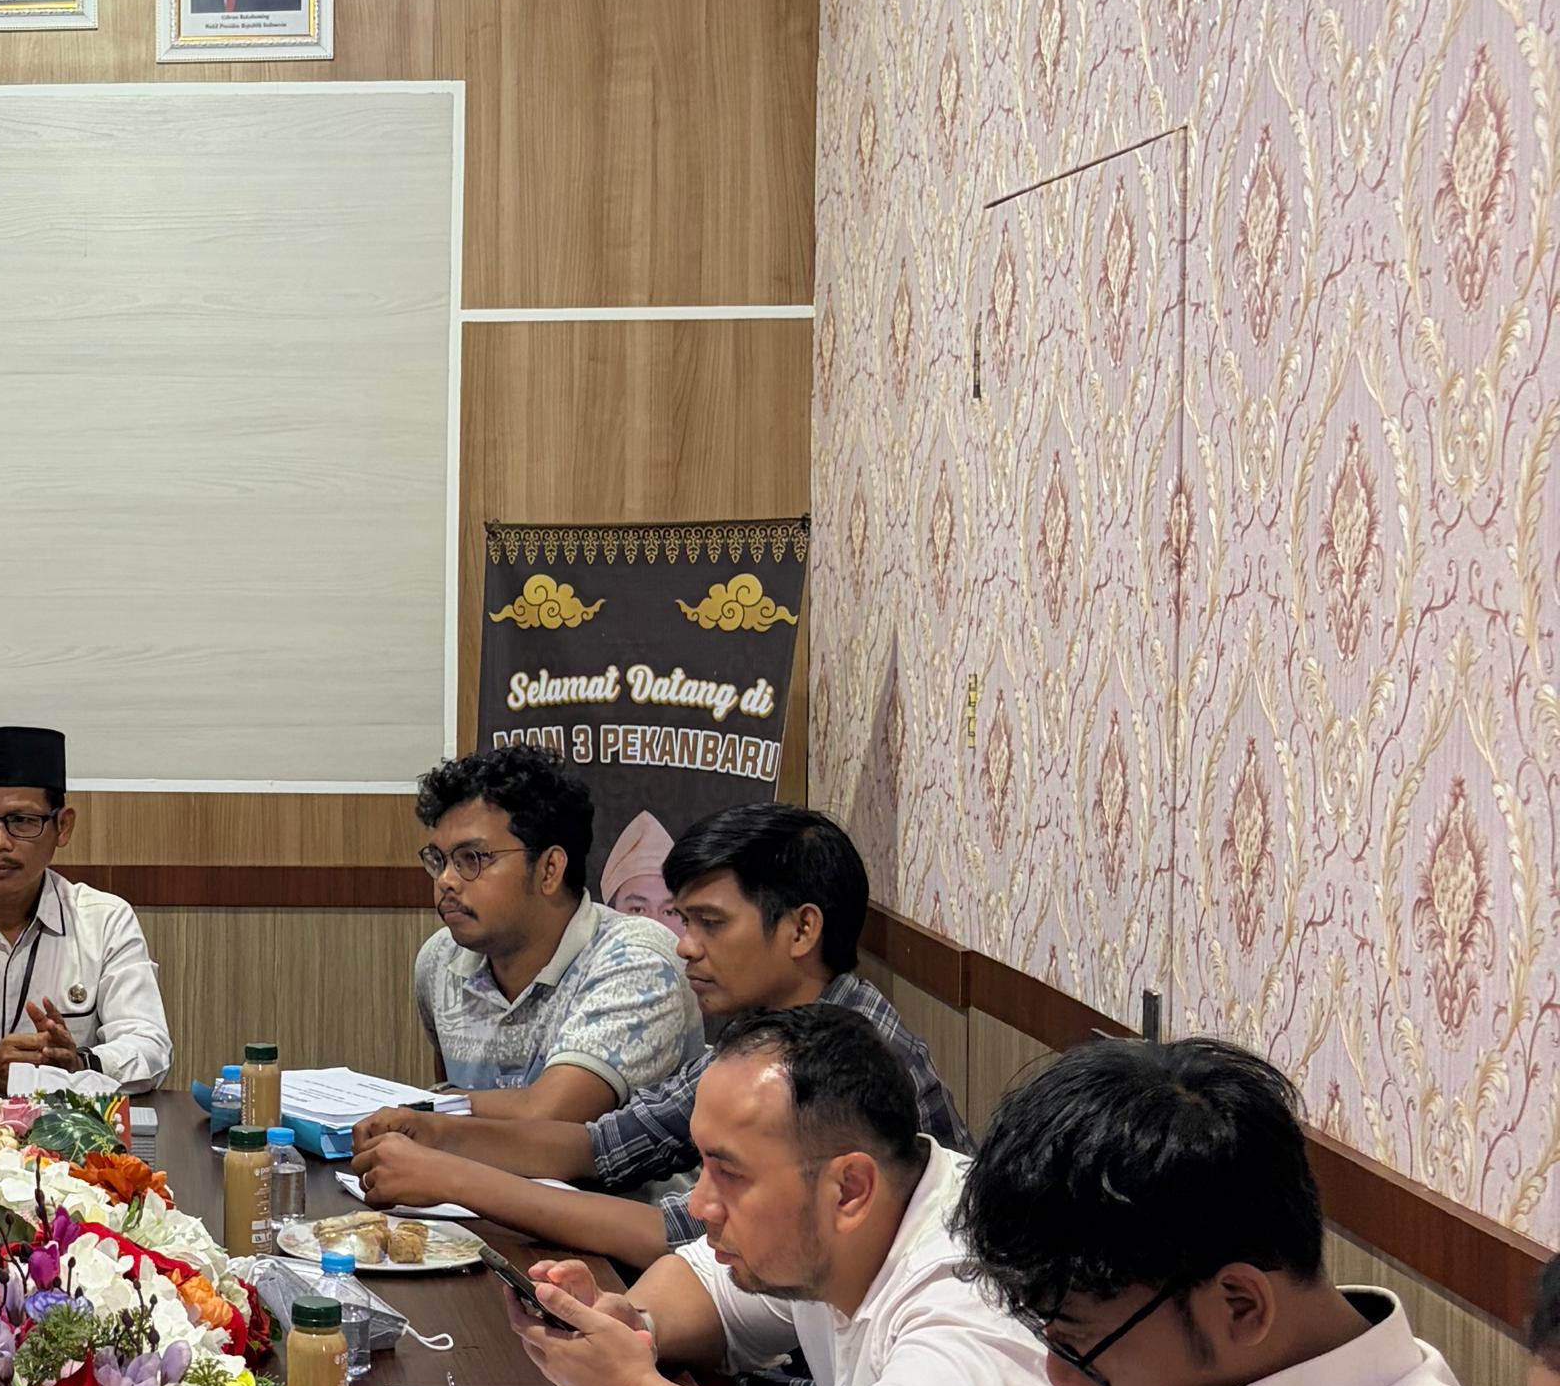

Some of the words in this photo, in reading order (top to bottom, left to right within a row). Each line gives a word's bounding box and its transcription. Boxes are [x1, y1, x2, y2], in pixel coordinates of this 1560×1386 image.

[507, 664, 621, 711] Selamat
[626, 664, 738, 722] Datang
[739, 677, 774, 718] di
[572, 724, 592, 763] 3
[600, 725, 780, 781] PEKANBARU
